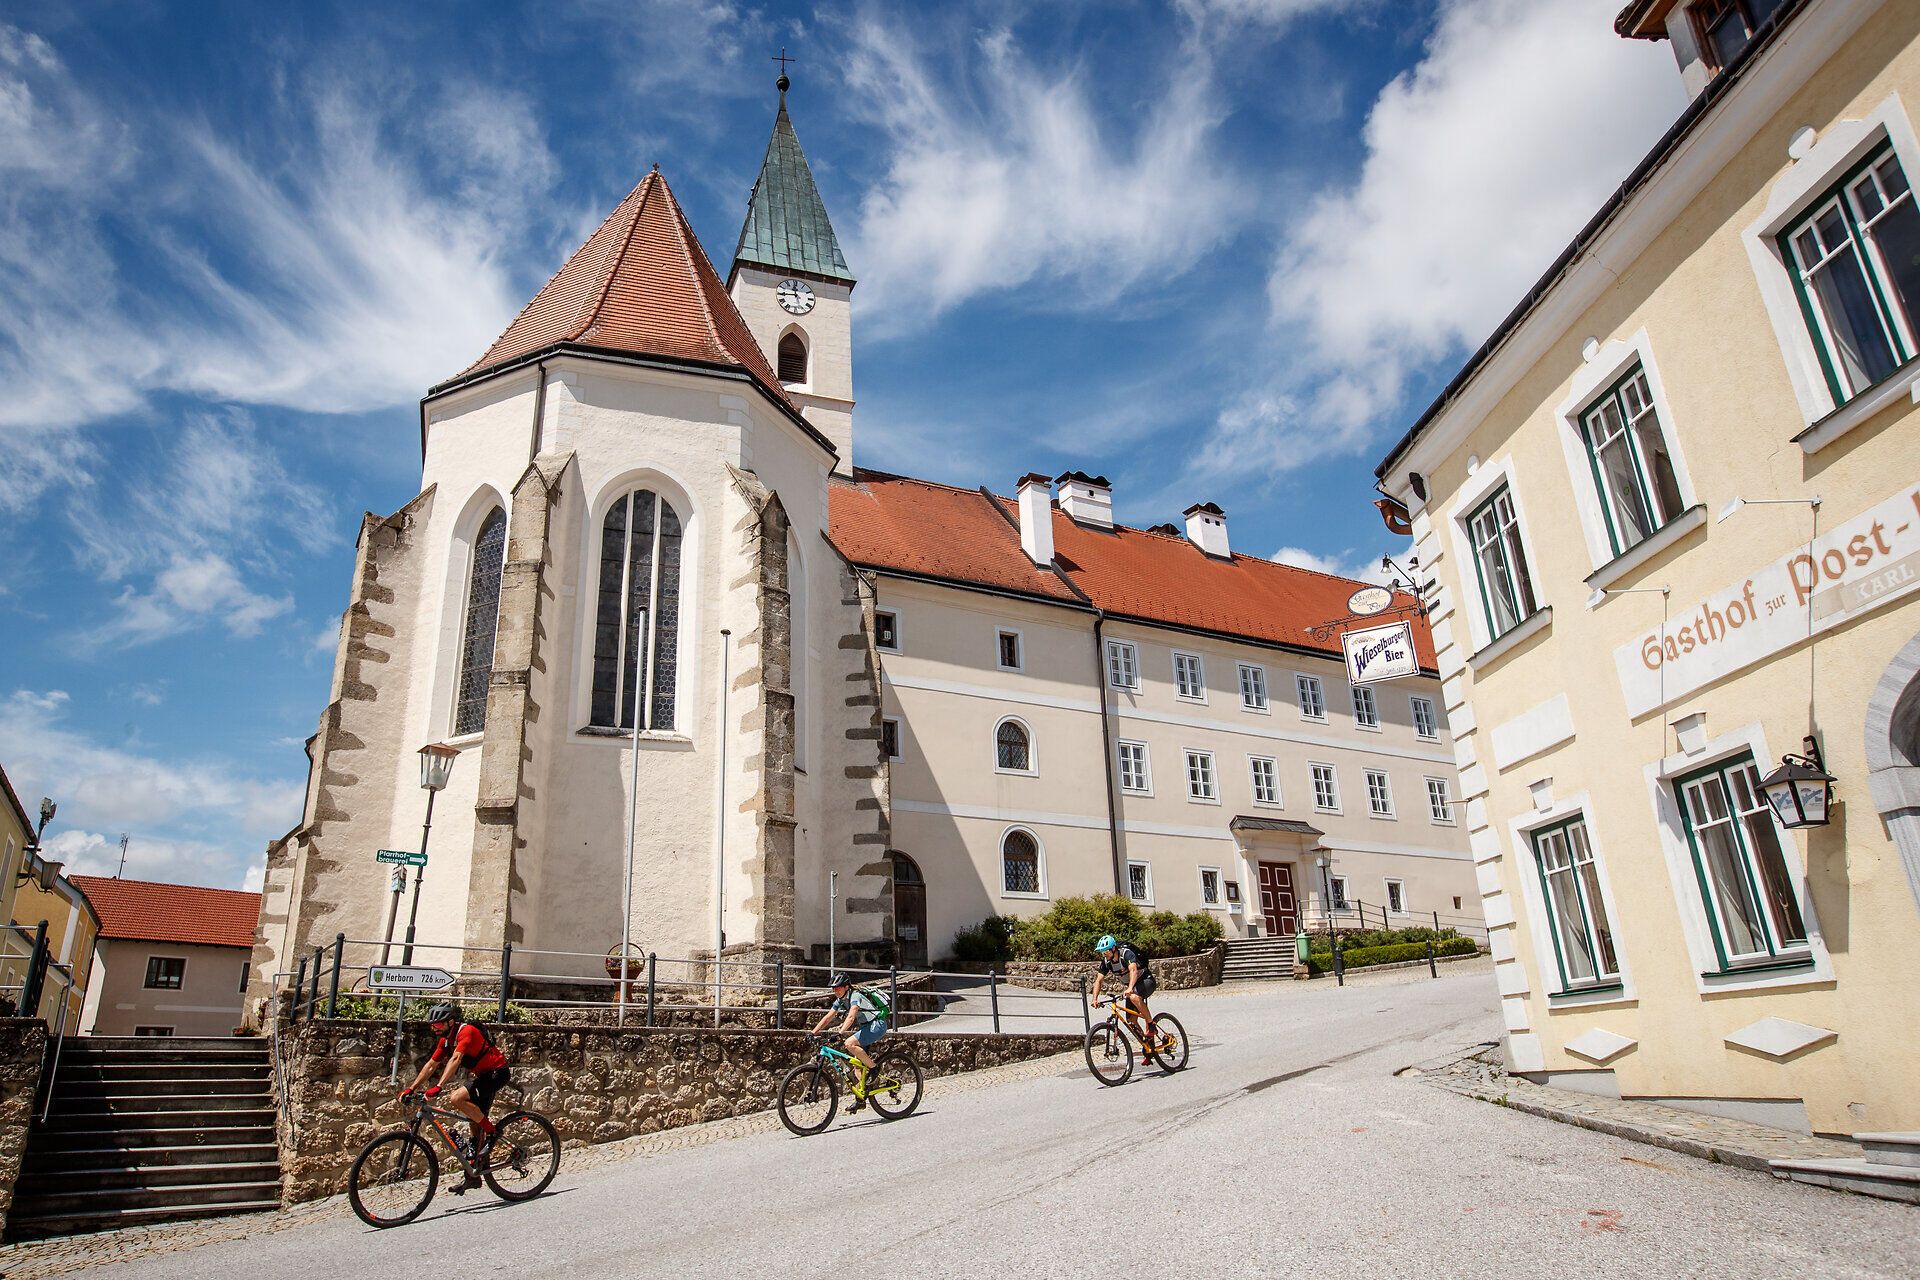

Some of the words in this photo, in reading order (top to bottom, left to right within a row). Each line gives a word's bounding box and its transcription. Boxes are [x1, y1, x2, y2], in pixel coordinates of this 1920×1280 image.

[1854, 563, 1916, 601] KARL
[1642, 579, 1757, 670] Gasthof
[1765, 594, 1787, 616] zur
[1354, 631, 1404, 679] Wieselburger
[1385, 650, 1404, 662] Bier
[379, 850, 410, 859] Pfarrhof-
[385, 972, 414, 983] Herborn
[421, 974, 434, 984] 726
